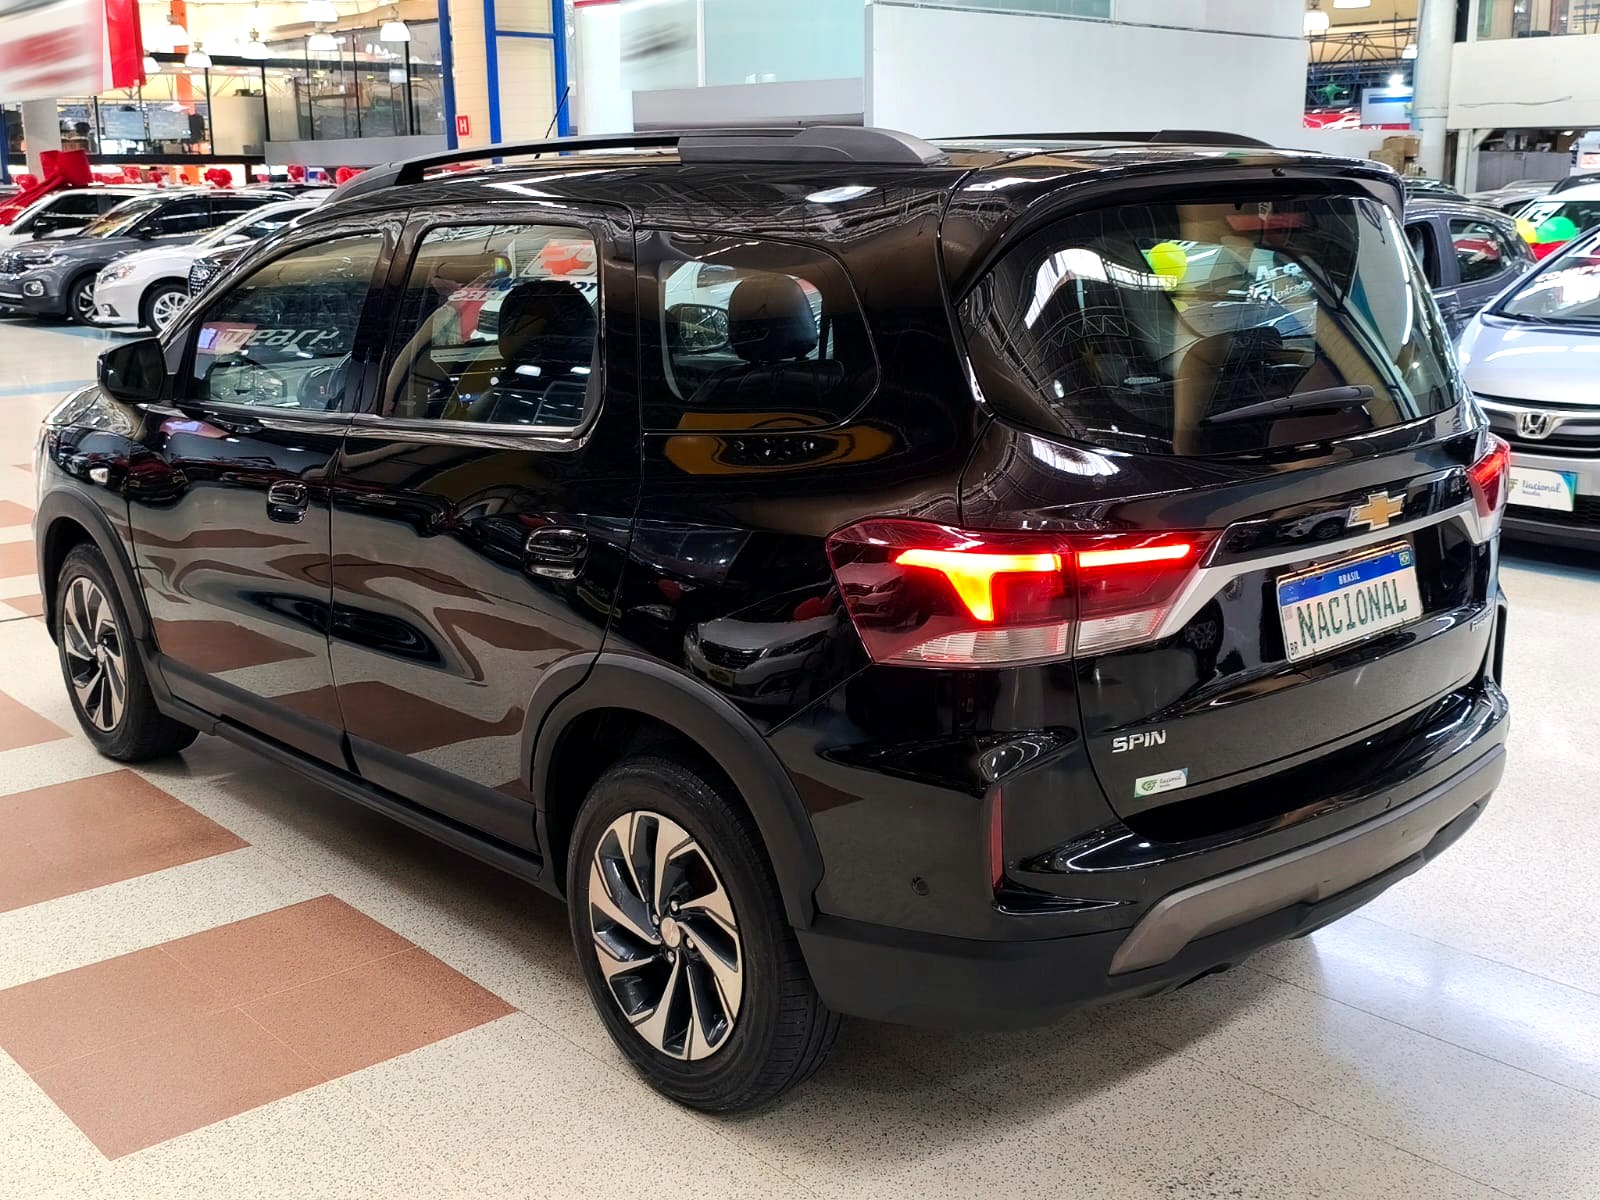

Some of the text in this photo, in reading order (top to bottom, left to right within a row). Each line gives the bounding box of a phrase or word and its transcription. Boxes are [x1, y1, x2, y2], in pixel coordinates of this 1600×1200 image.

[459, 118, 469, 134] H
[1338, 570, 1361, 585] BRASIL
[1296, 578, 1408, 647] NACIONAL
[1289, 641, 1299, 656] BR
[1111, 729, 1167, 754] SPIN
